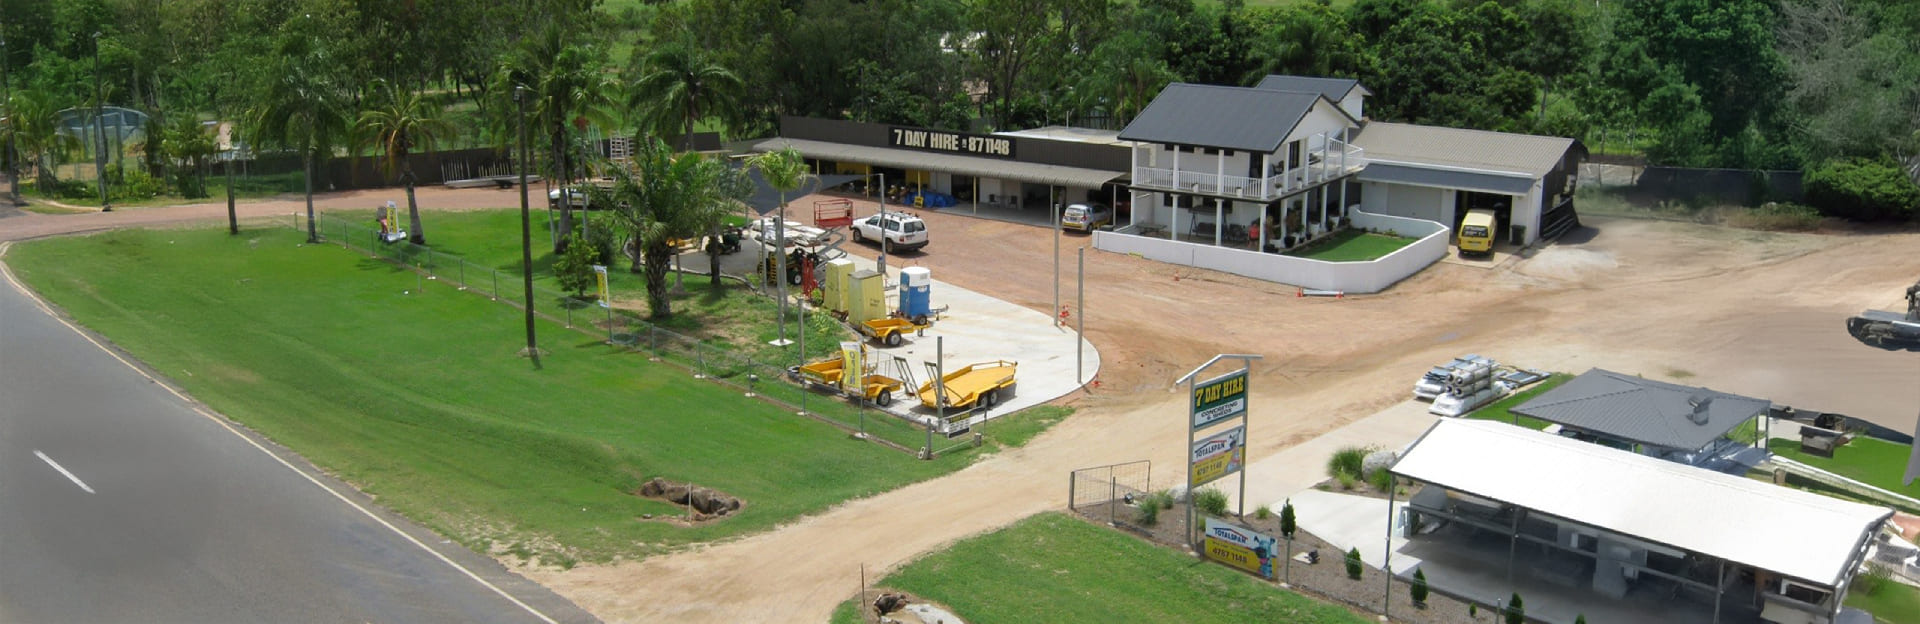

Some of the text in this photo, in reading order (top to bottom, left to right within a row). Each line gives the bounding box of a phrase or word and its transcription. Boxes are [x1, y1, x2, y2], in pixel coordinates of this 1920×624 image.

[894, 129, 903, 145] 7
[904, 129, 928, 148] DAY
[930, 132, 959, 151] HIRE
[1195, 375, 1244, 408] 7 DAY HIRE
[1200, 400, 1238, 418] CONCRETING
[1195, 443, 1225, 458] TOTALSPAN
[1214, 529, 1245, 543] TOTALSPAN
